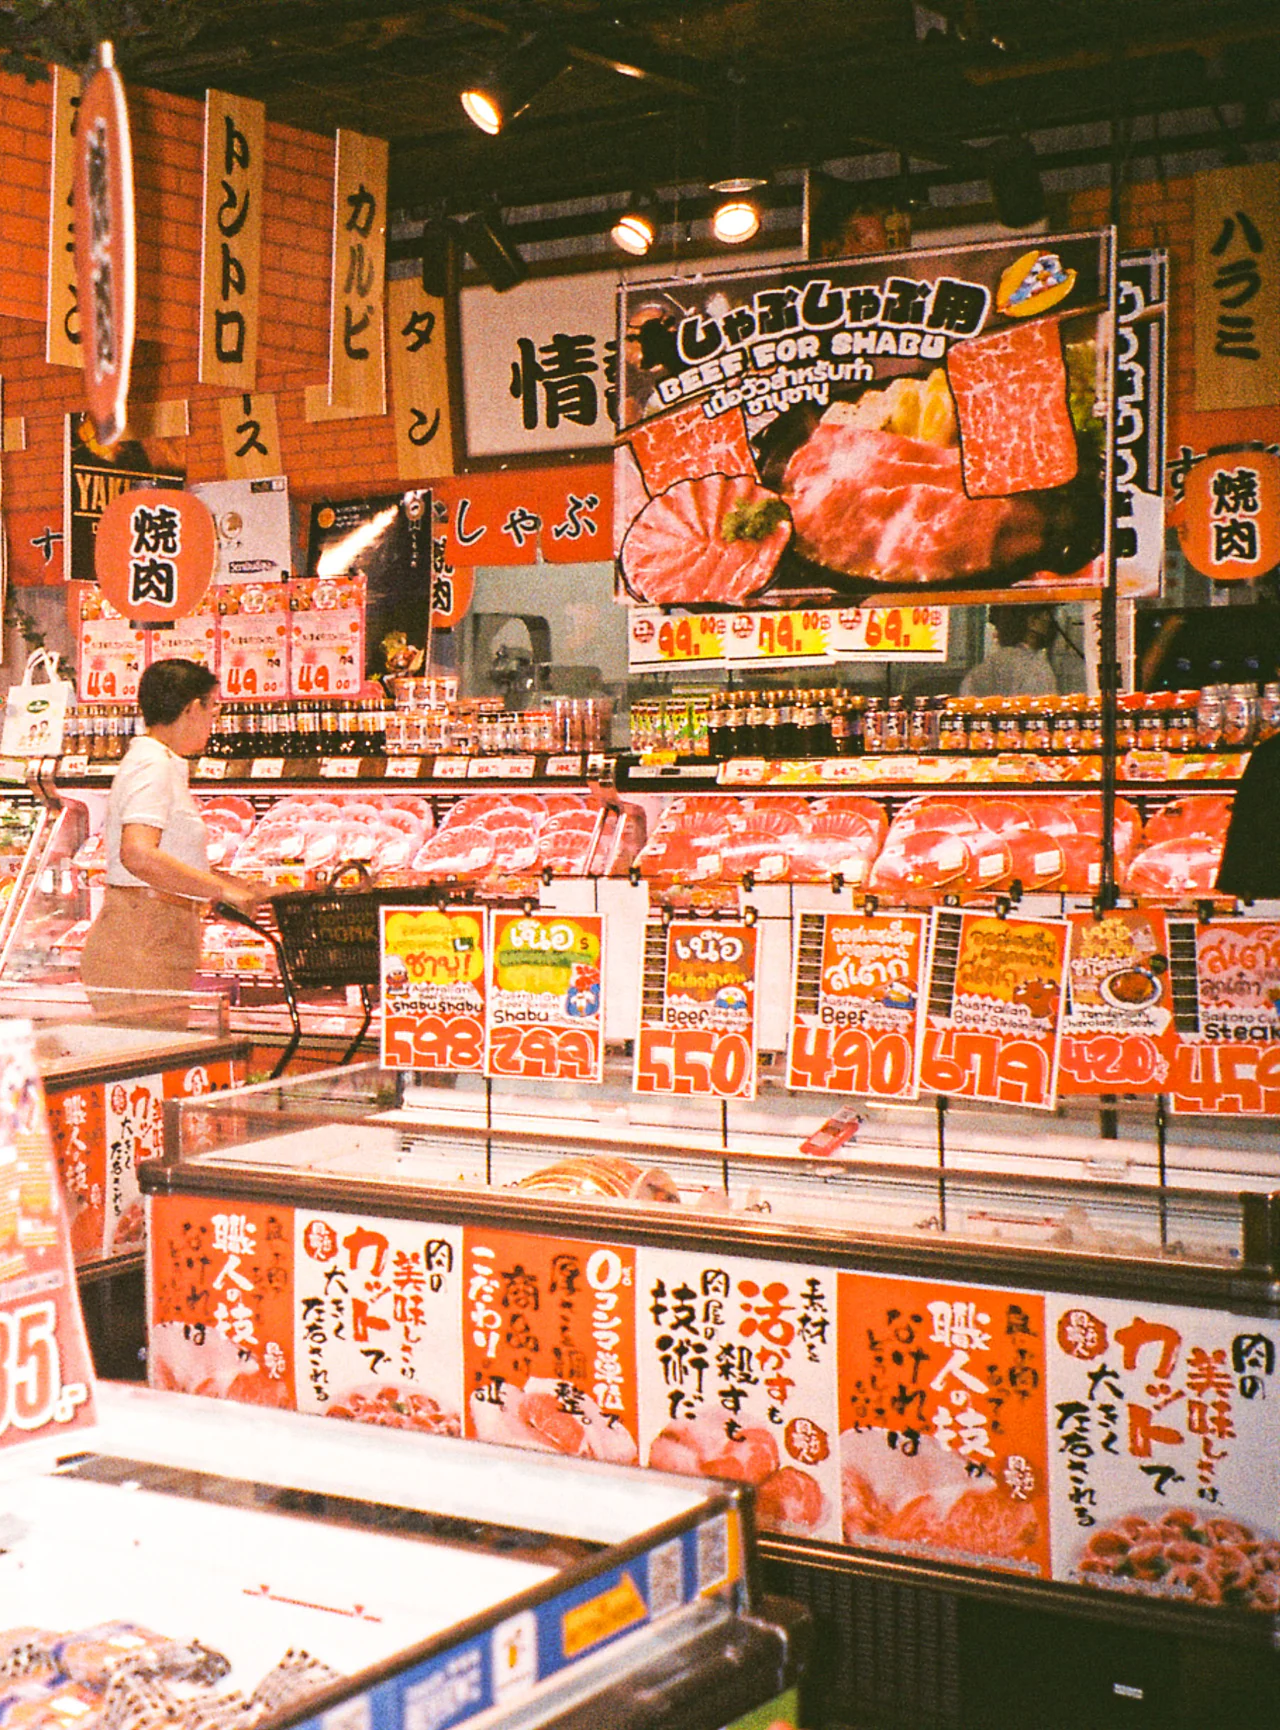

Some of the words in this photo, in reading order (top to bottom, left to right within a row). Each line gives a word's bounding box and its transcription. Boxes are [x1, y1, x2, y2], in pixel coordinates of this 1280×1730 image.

[214, 115, 252, 365] トントロ
[343, 184, 378, 361] カルビ
[1209, 210, 1263, 361] ハラミ
[400, 310, 442, 446] タン
[509, 332, 619, 431] 情
[659, 351, 744, 403] BEEF
[752, 334, 819, 369] FOR
[830, 331, 946, 359] SHABU
[746, 382, 830, 414] ชาบูชาบู
[235, 393, 269, 458] ース
[456, 493, 599, 547] しゃぶ
[1212, 469, 1261, 561] 焼肉
[132, 508, 180, 605] 焼肉
[227, 667, 258, 695] 49
[298, 664, 330, 692] 49
[405, 951, 471, 978] ชาบู!
[824, 955, 910, 991] สเต็ก
[385, 1015, 484, 1068] 598
[494, 1009, 549, 1024] Shabu
[667, 1007, 709, 1025] Beef
[821, 1006, 868, 1025] Beef
[954, 1010, 987, 1024] Beef
[489, 1024, 595, 1078] 299
[637, 1028, 751, 1096] 550
[791, 1027, 913, 1096] 490
[919, 1029, 1049, 1106] 679
[1059, 1034, 1158, 1084] 420
[423, 1238, 455, 1294] 肉の
[323, 1264, 349, 1341] 大きく
[700, 1268, 731, 1341] 肉屋の
[796, 1276, 831, 1364] 素材を
[301, 1297, 329, 1402] 左右される
[648, 1277, 710, 1421] 技術だ
[736, 1278, 797, 1426] 活かすも
[1231, 1332, 1277, 1400] 肉の
[1087, 1362, 1125, 1456] 大きく
[1113, 1315, 1187, 1497] カットで
[1055, 1400, 1097, 1528] 左右される
